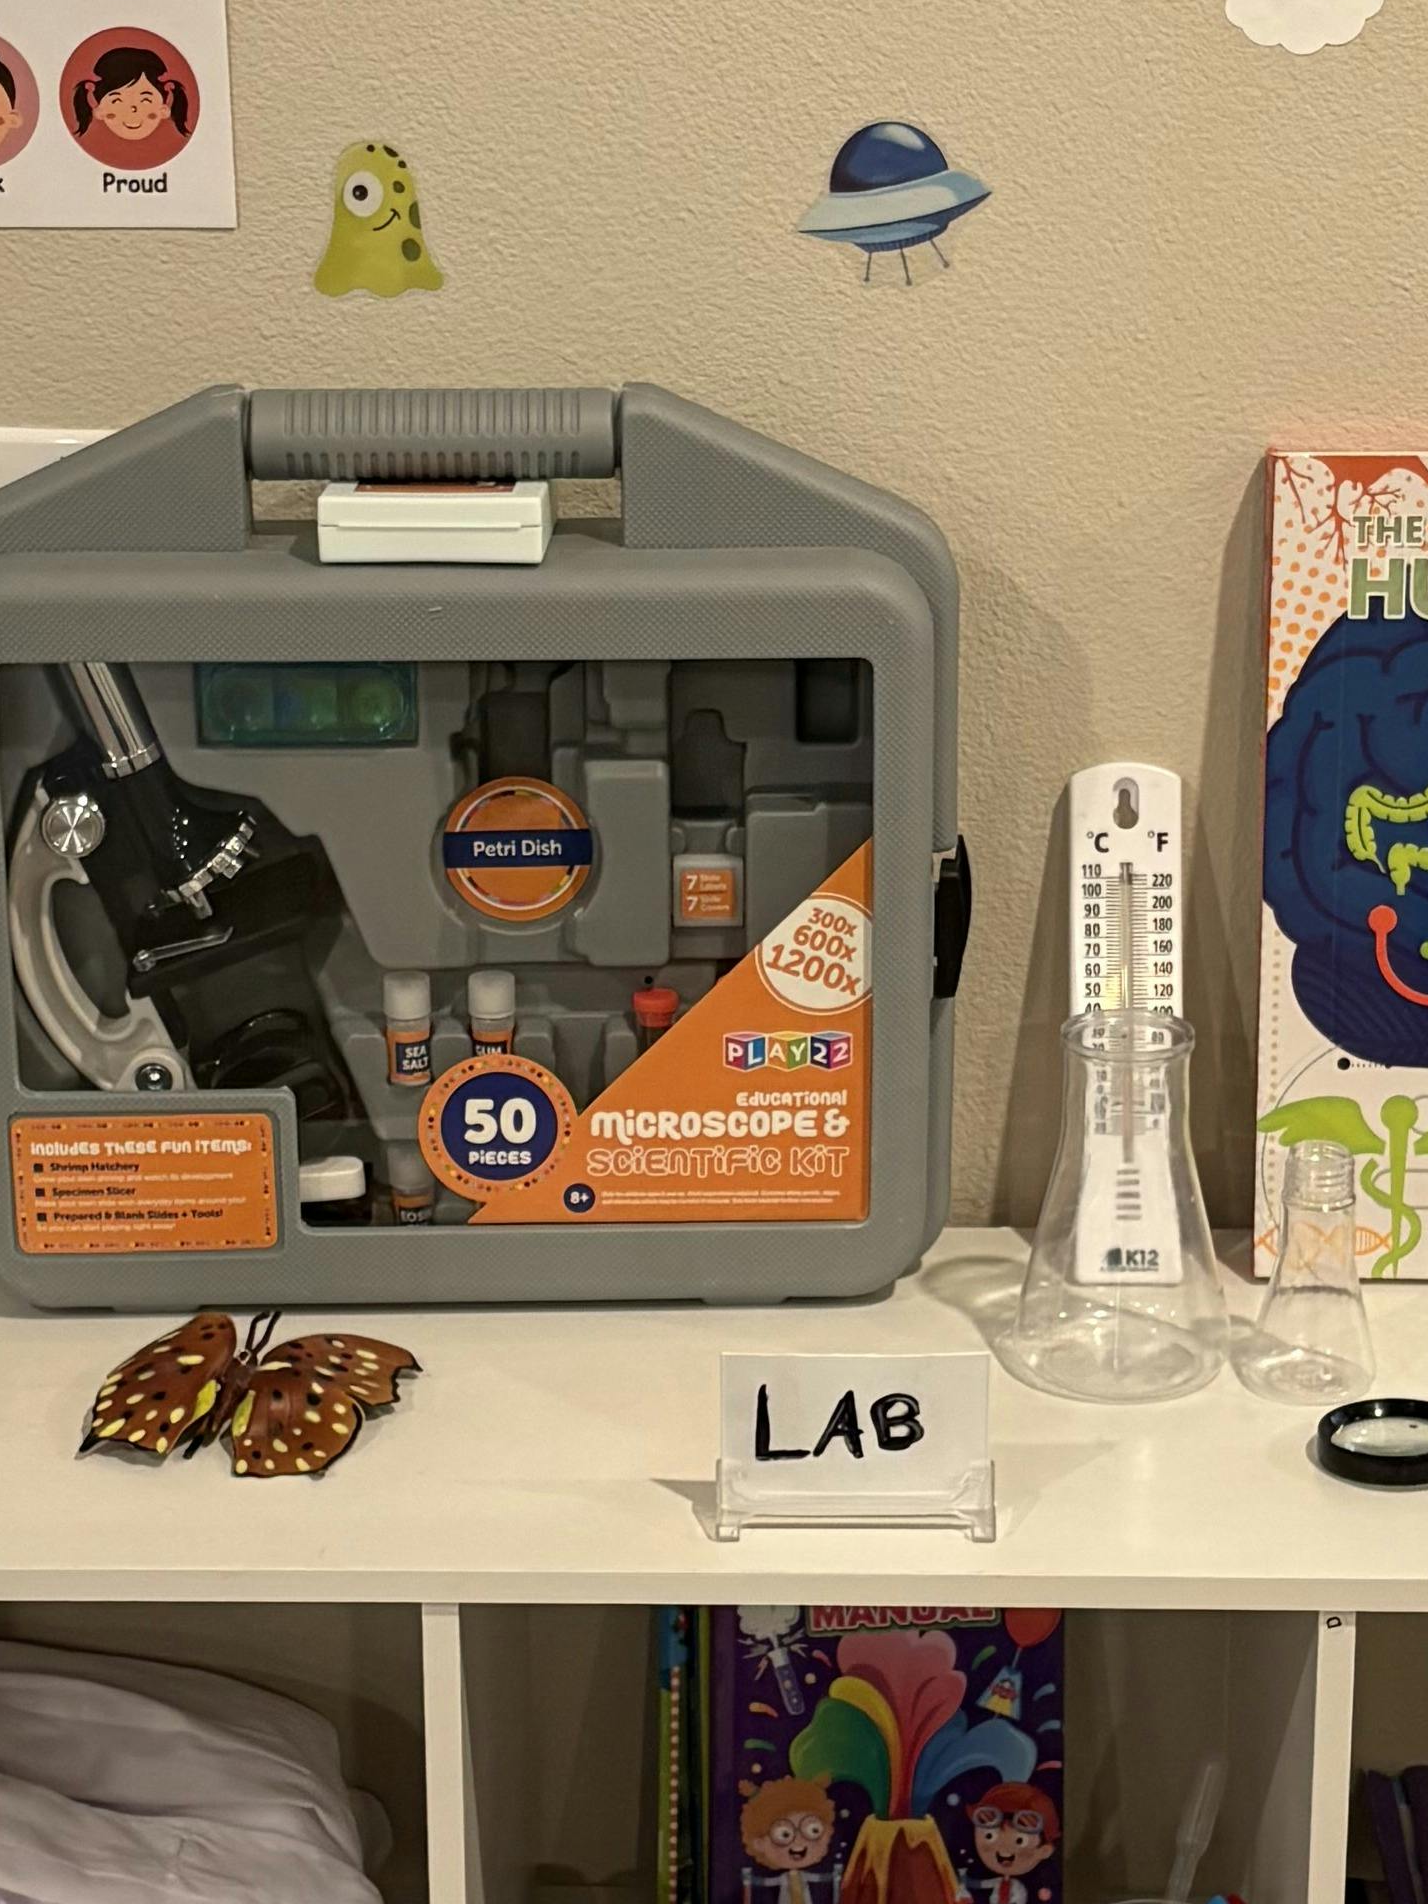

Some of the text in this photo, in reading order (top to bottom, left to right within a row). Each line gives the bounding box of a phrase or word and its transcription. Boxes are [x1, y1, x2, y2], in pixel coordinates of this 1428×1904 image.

[103, 173, 168, 194] Proud
[1353, 515, 1425, 547] THE
[473, 839, 562, 856] Petri Dish
[1087, 831, 1109, 853] °C
[1148, 831, 1169, 852] °F
[1082, 864, 1101, 877] 110
[686, 875, 698, 890] 7
[1152, 874, 1172, 887] 220
[1082, 883, 1102, 897] 100
[687, 897, 699, 913] 7
[1152, 896, 1172, 909] 200
[1084, 904, 1100, 917] 90
[807, 908, 857, 937] 300x
[1153, 918, 1172, 931] 180
[1084, 924, 1100, 937] 80
[793, 925, 857, 962] 600x
[1085, 944, 1100, 956] 70
[1153, 940, 1173, 953] 160
[766, 944, 861, 995] 1200x
[1085, 963, 1101, 976] 60
[1153, 962, 1173, 975] 140
[1085, 983, 1101, 996] 50
[1154, 984, 1173, 997] 120
[404, 1045, 426, 1059] SEA
[727, 1036, 850, 1065] PLAY22
[402, 1058, 429, 1070] SALT
[464, 1098, 536, 1145] 50
[826, 1117, 850, 1136] &
[571, 1190, 589, 1205] 8+
[1125, 1249, 1159, 1267] K12
[755, 1384, 924, 1461] LAB
